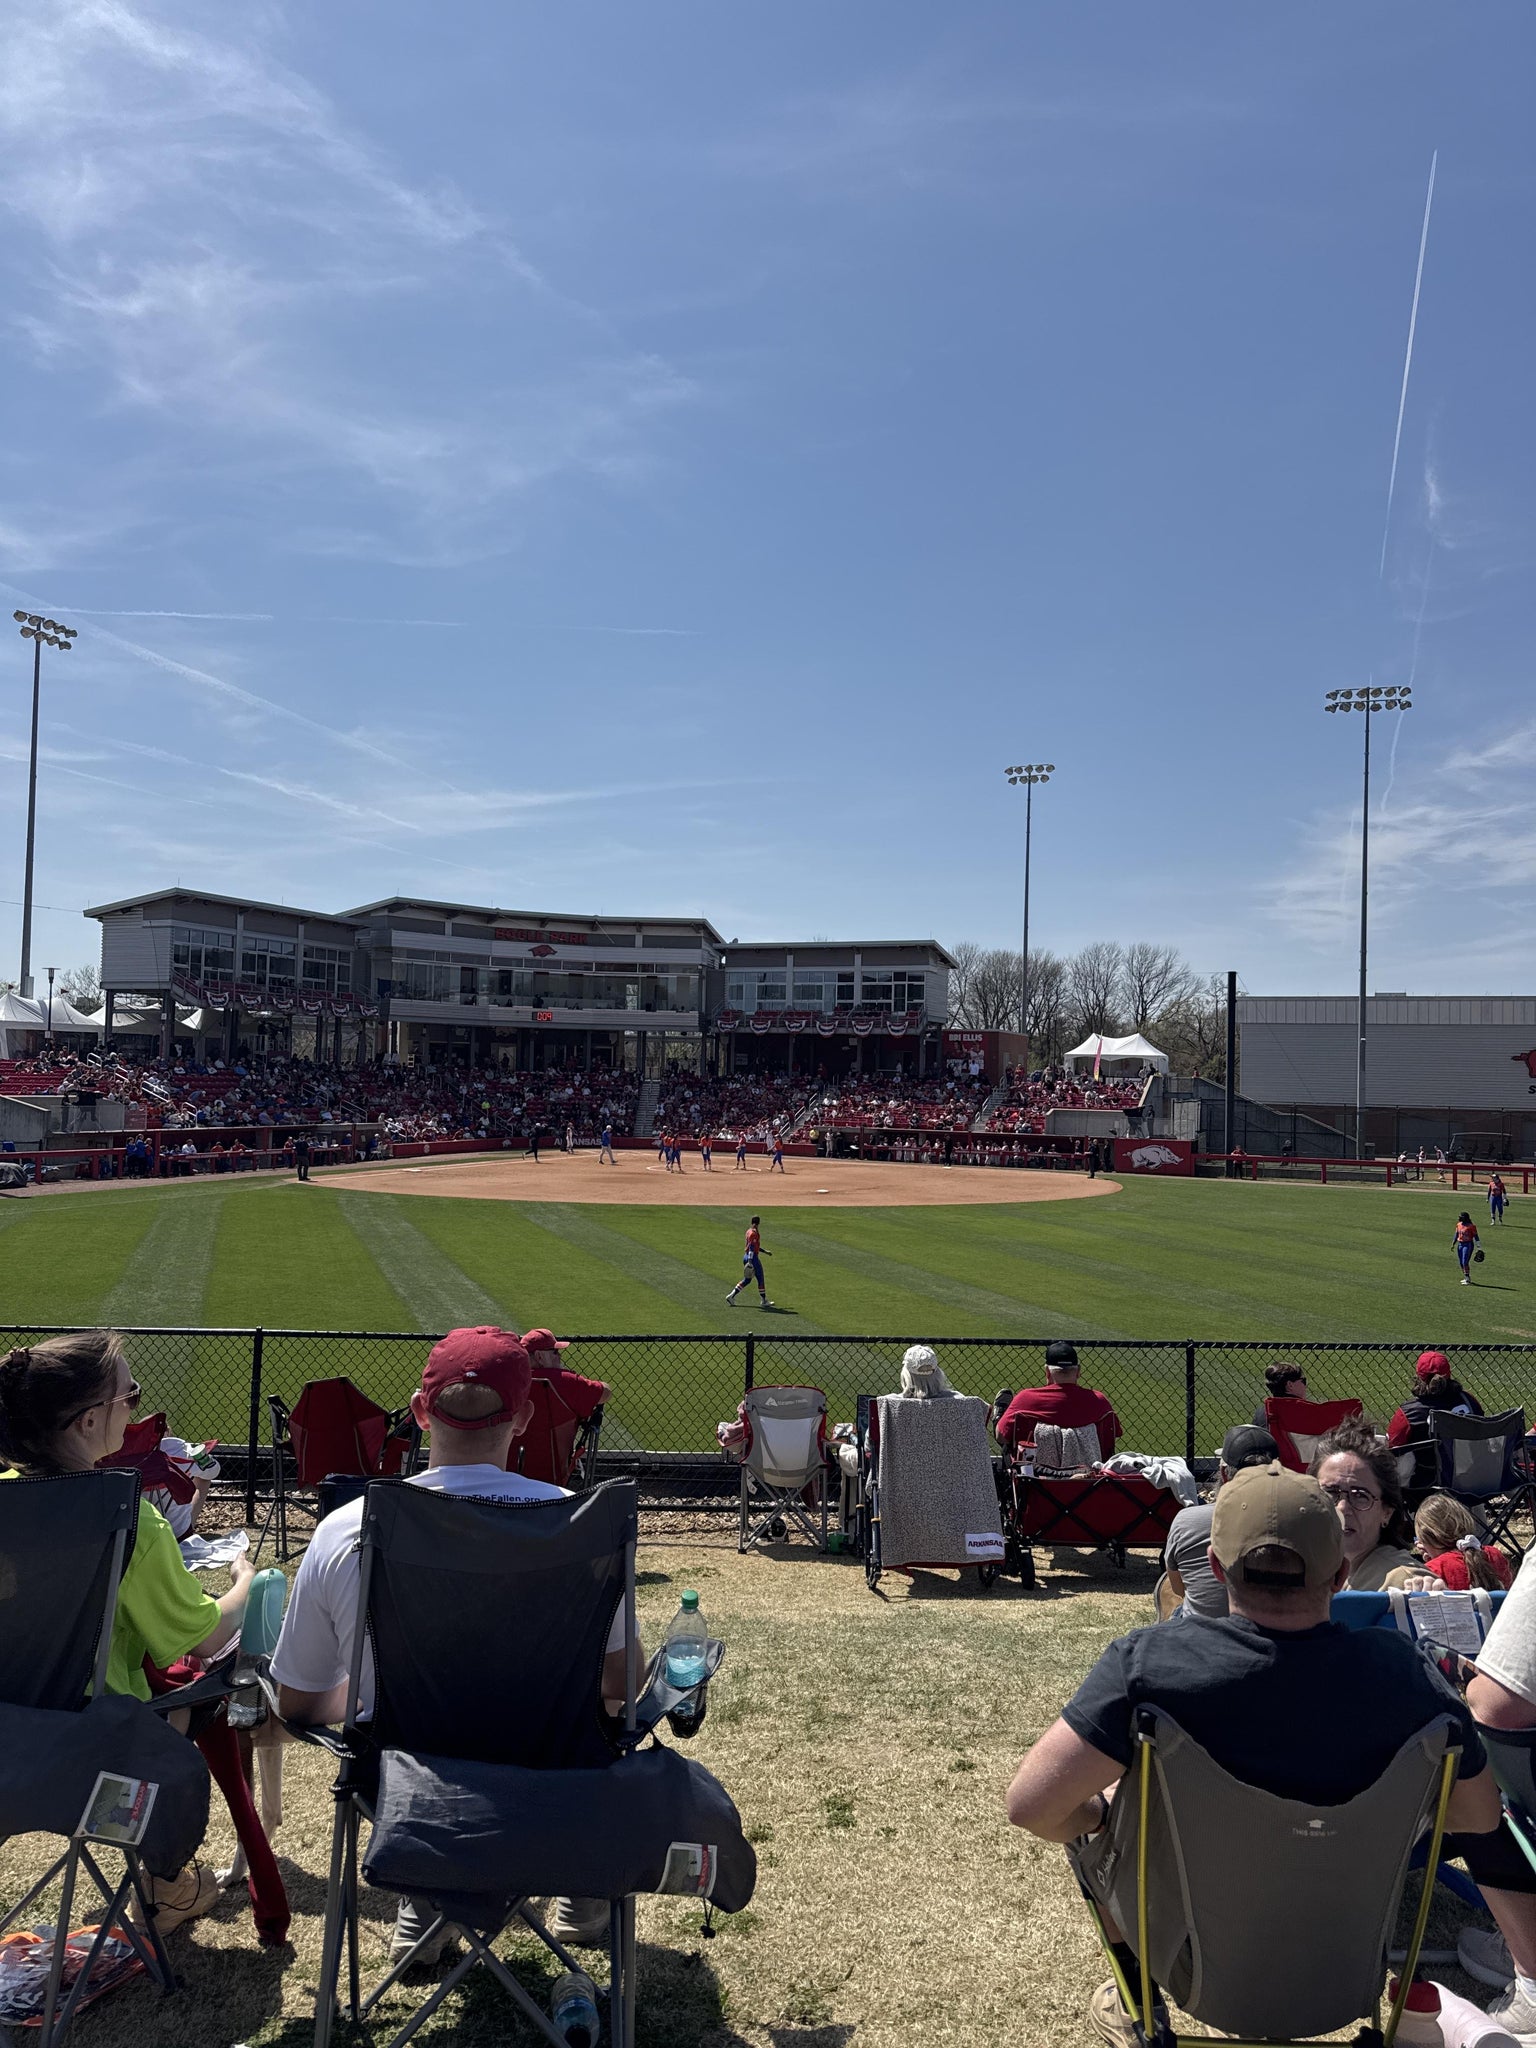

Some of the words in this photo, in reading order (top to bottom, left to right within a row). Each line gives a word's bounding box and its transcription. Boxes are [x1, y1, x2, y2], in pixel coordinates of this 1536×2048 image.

[495, 928, 545, 941] BOGLE
[550, 931, 588, 943] PARK
[968, 1540, 1003, 1548] ARKANSAS
